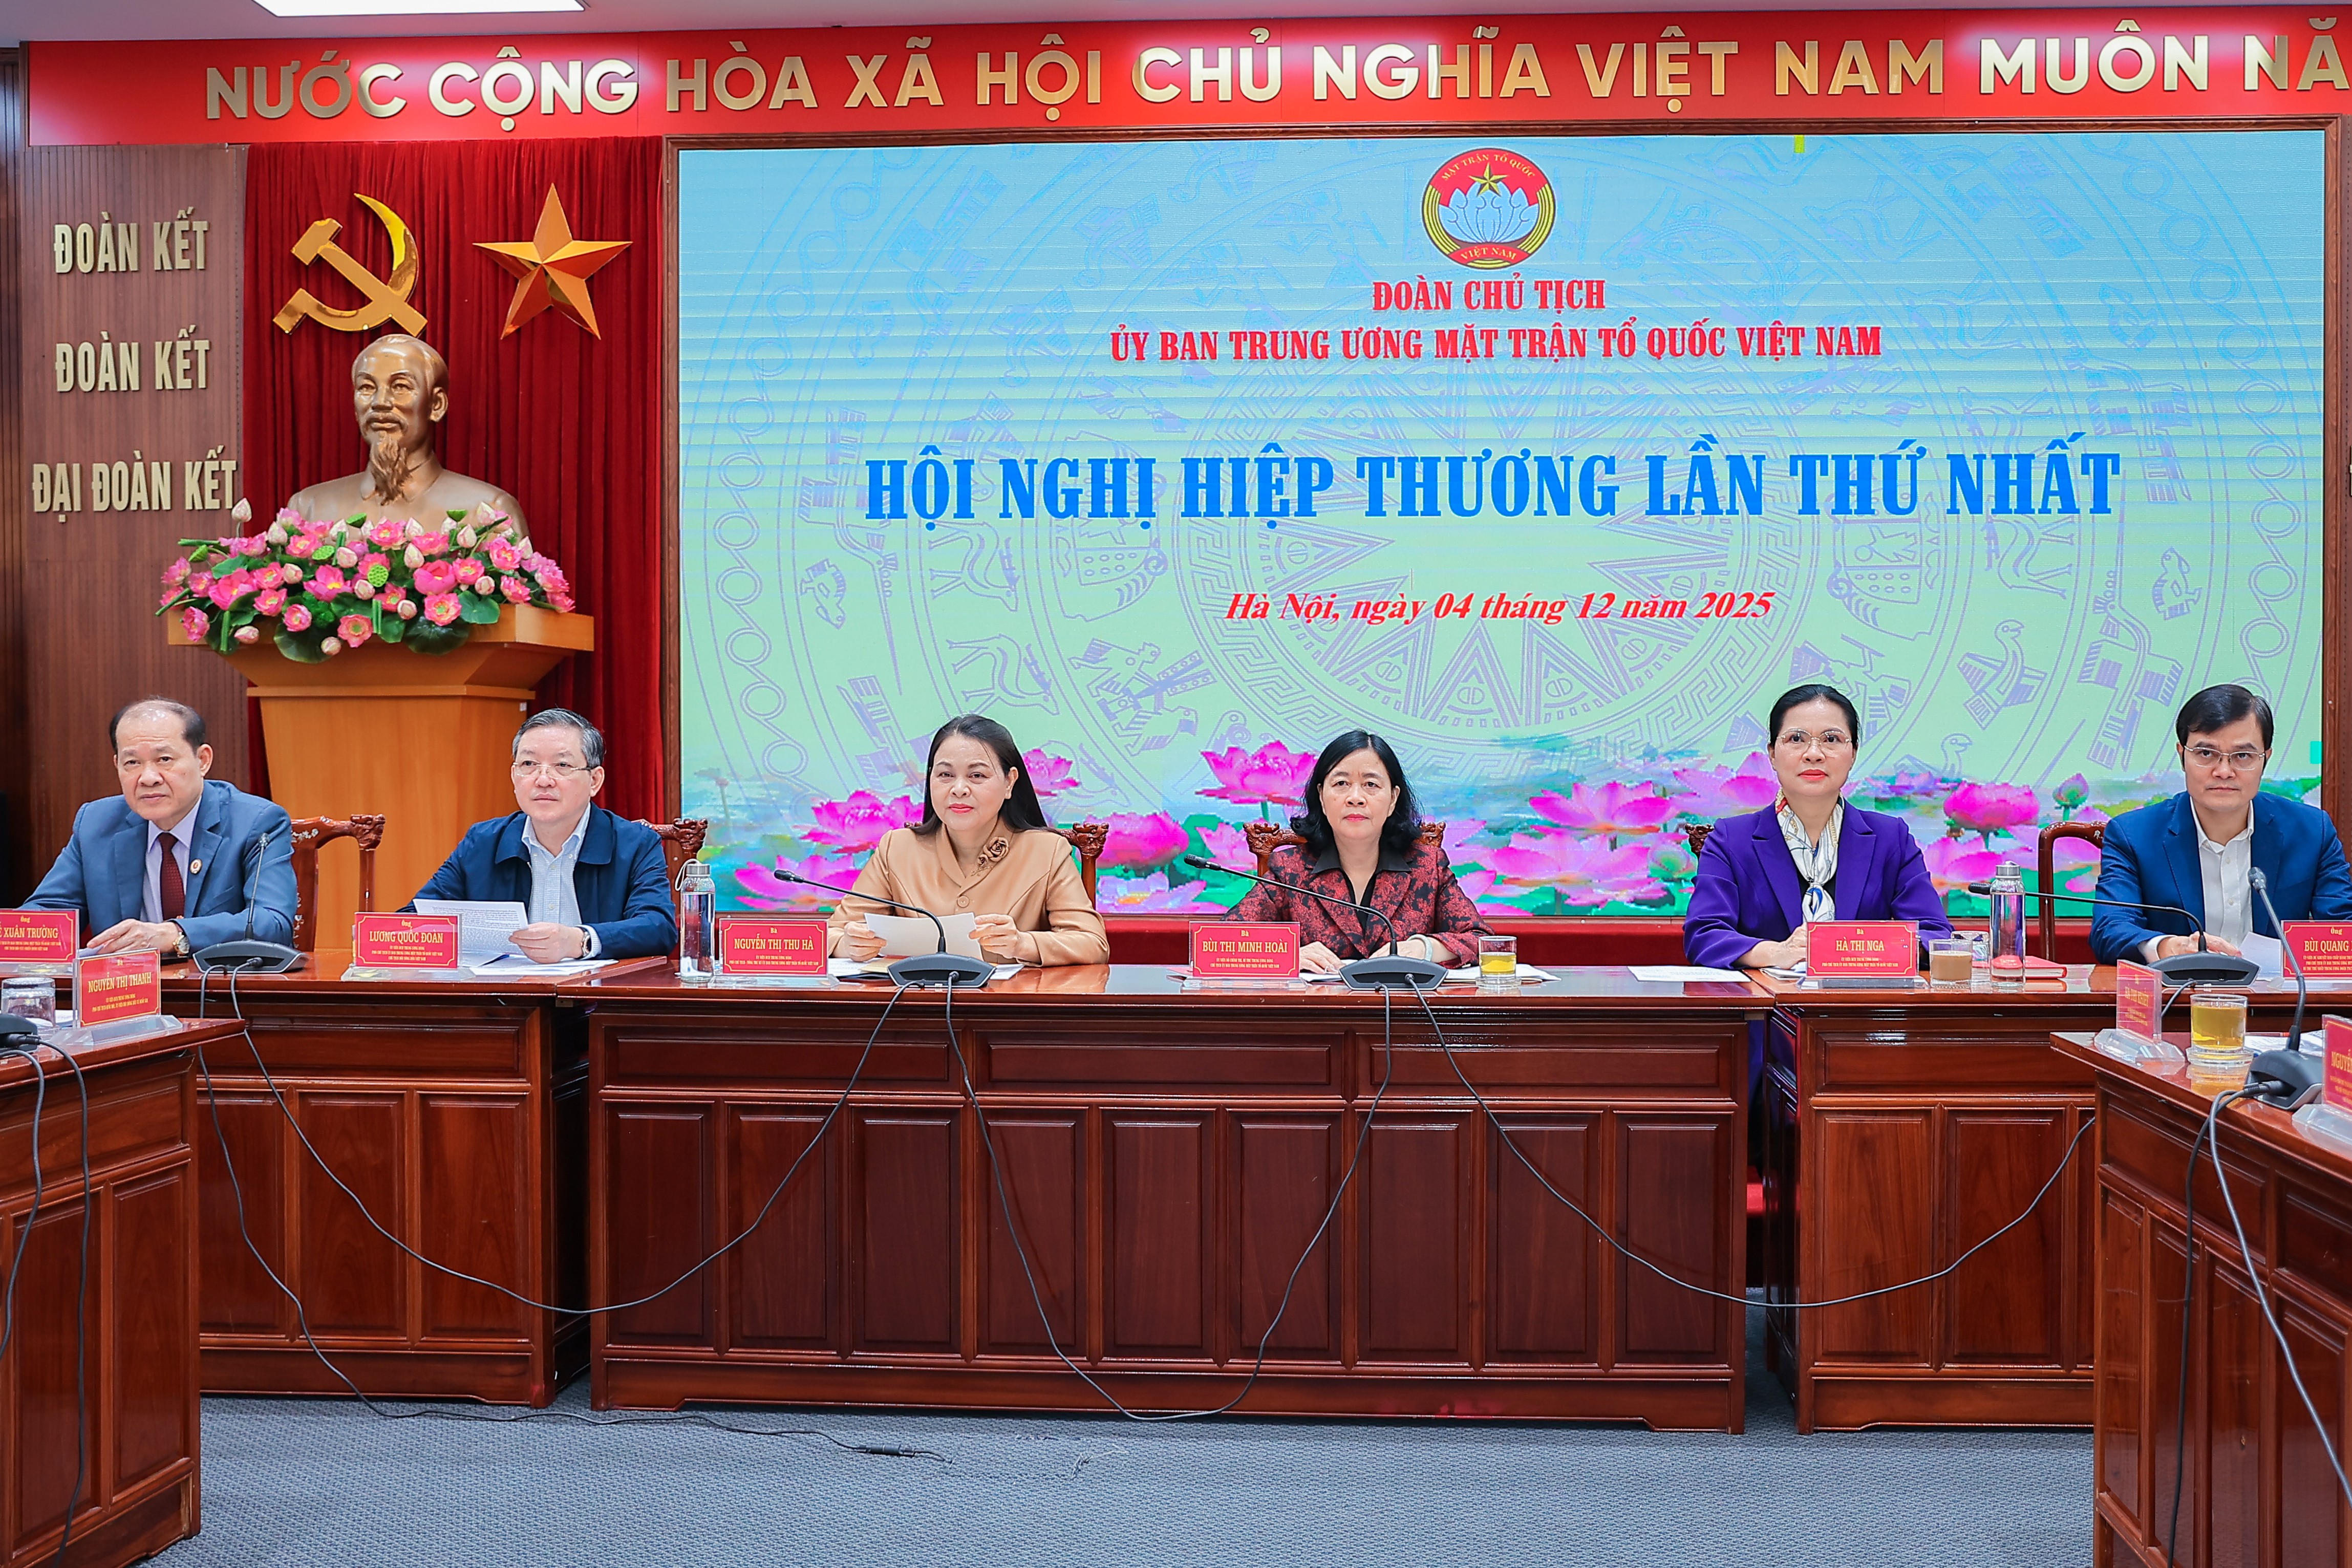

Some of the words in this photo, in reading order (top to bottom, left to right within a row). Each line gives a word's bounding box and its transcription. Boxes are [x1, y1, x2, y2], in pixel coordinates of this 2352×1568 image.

[206, 50, 408, 120] NƯỚC
[427, 46, 639, 132] CỘNG
[667, 41, 818, 112] HÒA
[844, 35, 944, 109] XÃ
[977, 33, 1101, 122] HỘI
[1132, 27, 1281, 103] CHỦ
[1313, 26, 1551, 101] NGHĨA
[1576, 26, 1738, 114] VIỆT
[1776, 38, 1944, 96] NAM
[1979, 19, 2208, 95] MUÔN
[1494, 153, 1508, 162] TỔ
[54, 211, 139, 273] ĐOÀN
[154, 206, 209, 270] KẾT
[1461, 247, 1488, 261] VIỆT
[1491, 247, 1517, 261] NAM
[1372, 275, 1453, 311] ĐOÀN
[1463, 272, 1524, 310] CHỦ
[1534, 280, 1606, 314] TỊCH
[1110, 324, 1149, 361] ỦY
[1159, 331, 1218, 360] BAN
[1229, 330, 1331, 360] TRUNG
[1341, 327, 1423, 359] ƯƠNG
[1435, 324, 1499, 363] MẶT
[1508, 322, 1588, 363] TRẬN
[1598, 316, 1637, 357] TỔ
[1647, 318, 1726, 360] QUỐC
[1736, 320, 1805, 361] VIỆT
[1815, 327, 1881, 356] NAM
[55, 331, 140, 392] ĐOÀN
[155, 324, 210, 390] KẾT
[32, 463, 81, 523] ĐẠI
[92, 450, 172, 511] ĐOÀN
[185, 445, 237, 510] KẾT
[865, 444, 975, 531] HỘI
[999, 458, 1156, 530] NGHỊ
[1181, 442, 1334, 529] HIỆP
[1356, 448, 1620, 517] THƯƠNG
[1645, 434, 1767, 516] LẦN
[1789, 439, 1928, 515] THỨ
[1946, 432, 2121, 515] NHẤT
[1224, 593, 1270, 619] Hà
[1278, 593, 1339, 624] Nội,
[1351, 592, 1427, 625] ngày
[1434, 592, 1474, 618] 04
[1482, 592, 1569, 625] tháng
[1575, 592, 1616, 618] 12
[1619, 594, 1688, 618] năm
[1693, 592, 1776, 618] 2025
[4, 925, 25, 938] XUÂN
[27, 925, 58, 938] TRƯỜNG
[369, 931, 396, 942] LƯƠNG
[397, 927, 419, 944] QUỐC
[421, 929, 443, 943] ĐOÀN
[2330, 927, 2343, 935] Ông
[734, 933, 766, 949] NGUYỄN
[768, 939, 782, 953] THỊ
[783, 939, 800, 950] THU
[802, 936, 814, 950] HÀ
[1202, 937, 1217, 952] BÙI
[1220, 941, 1235, 955] THỊ
[1237, 941, 1263, 953] MINH
[1265, 938, 1288, 953] HOÀI
[1836, 936, 1849, 951] HÀ
[1850, 940, 1865, 954] THỊ
[1866, 940, 1885, 951] NGA
[2304, 937, 2319, 952] BÙI
[2320, 940, 2349, 954] QUANG
[88, 972, 115, 993] NGUYỄN
[116, 975, 128, 990] THỊ
[129, 972, 152, 986] THANH
[2331, 1049, 2352, 1073] NGUYỄ
